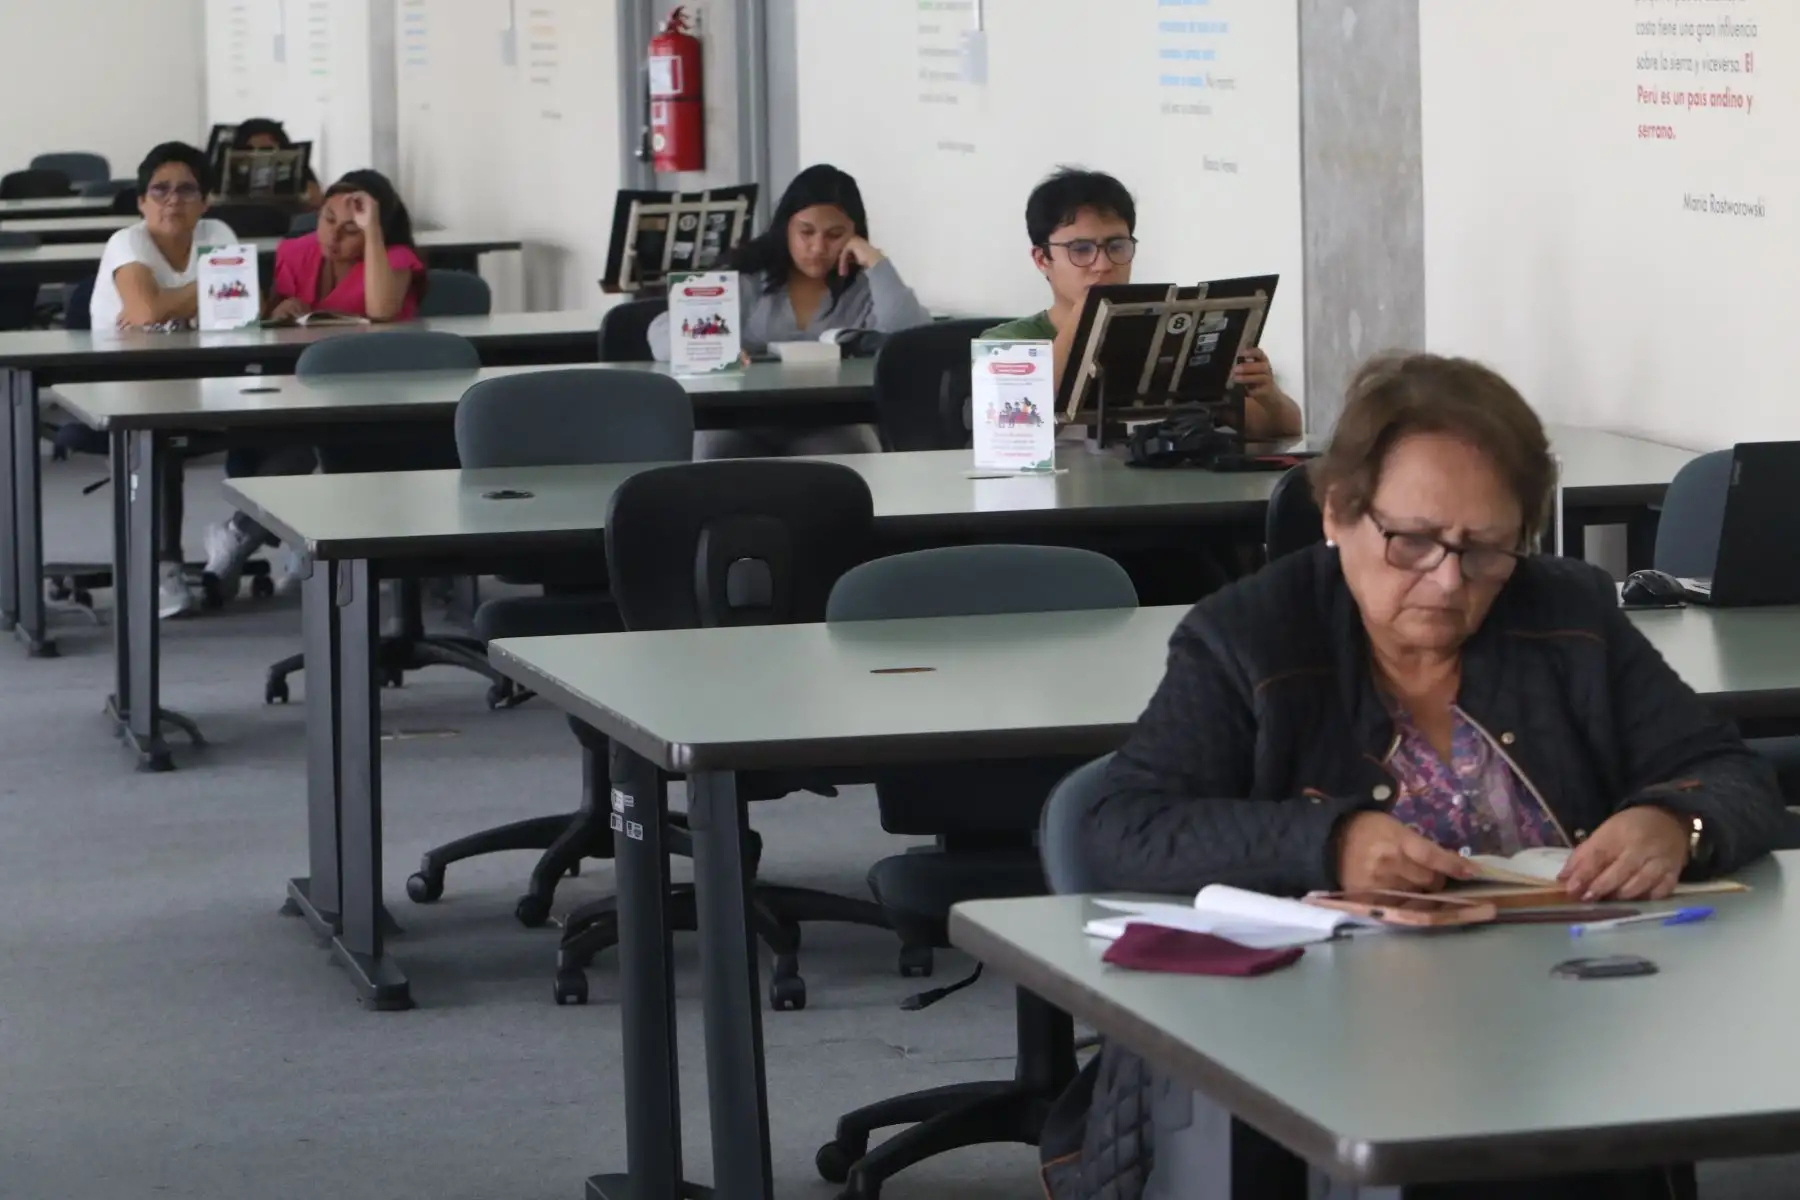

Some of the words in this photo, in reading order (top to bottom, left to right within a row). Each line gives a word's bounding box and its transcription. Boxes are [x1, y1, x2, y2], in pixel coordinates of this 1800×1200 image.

[1745, 50, 1754, 73] El
[1661, 90, 1671, 105] es
[1673, 91, 1685, 106] un
[1710, 86, 1743, 108] andino
[1746, 94, 1753, 115] y
[1710, 193, 1766, 217] Rostworowski
[1173, 317, 1185, 329] 8
